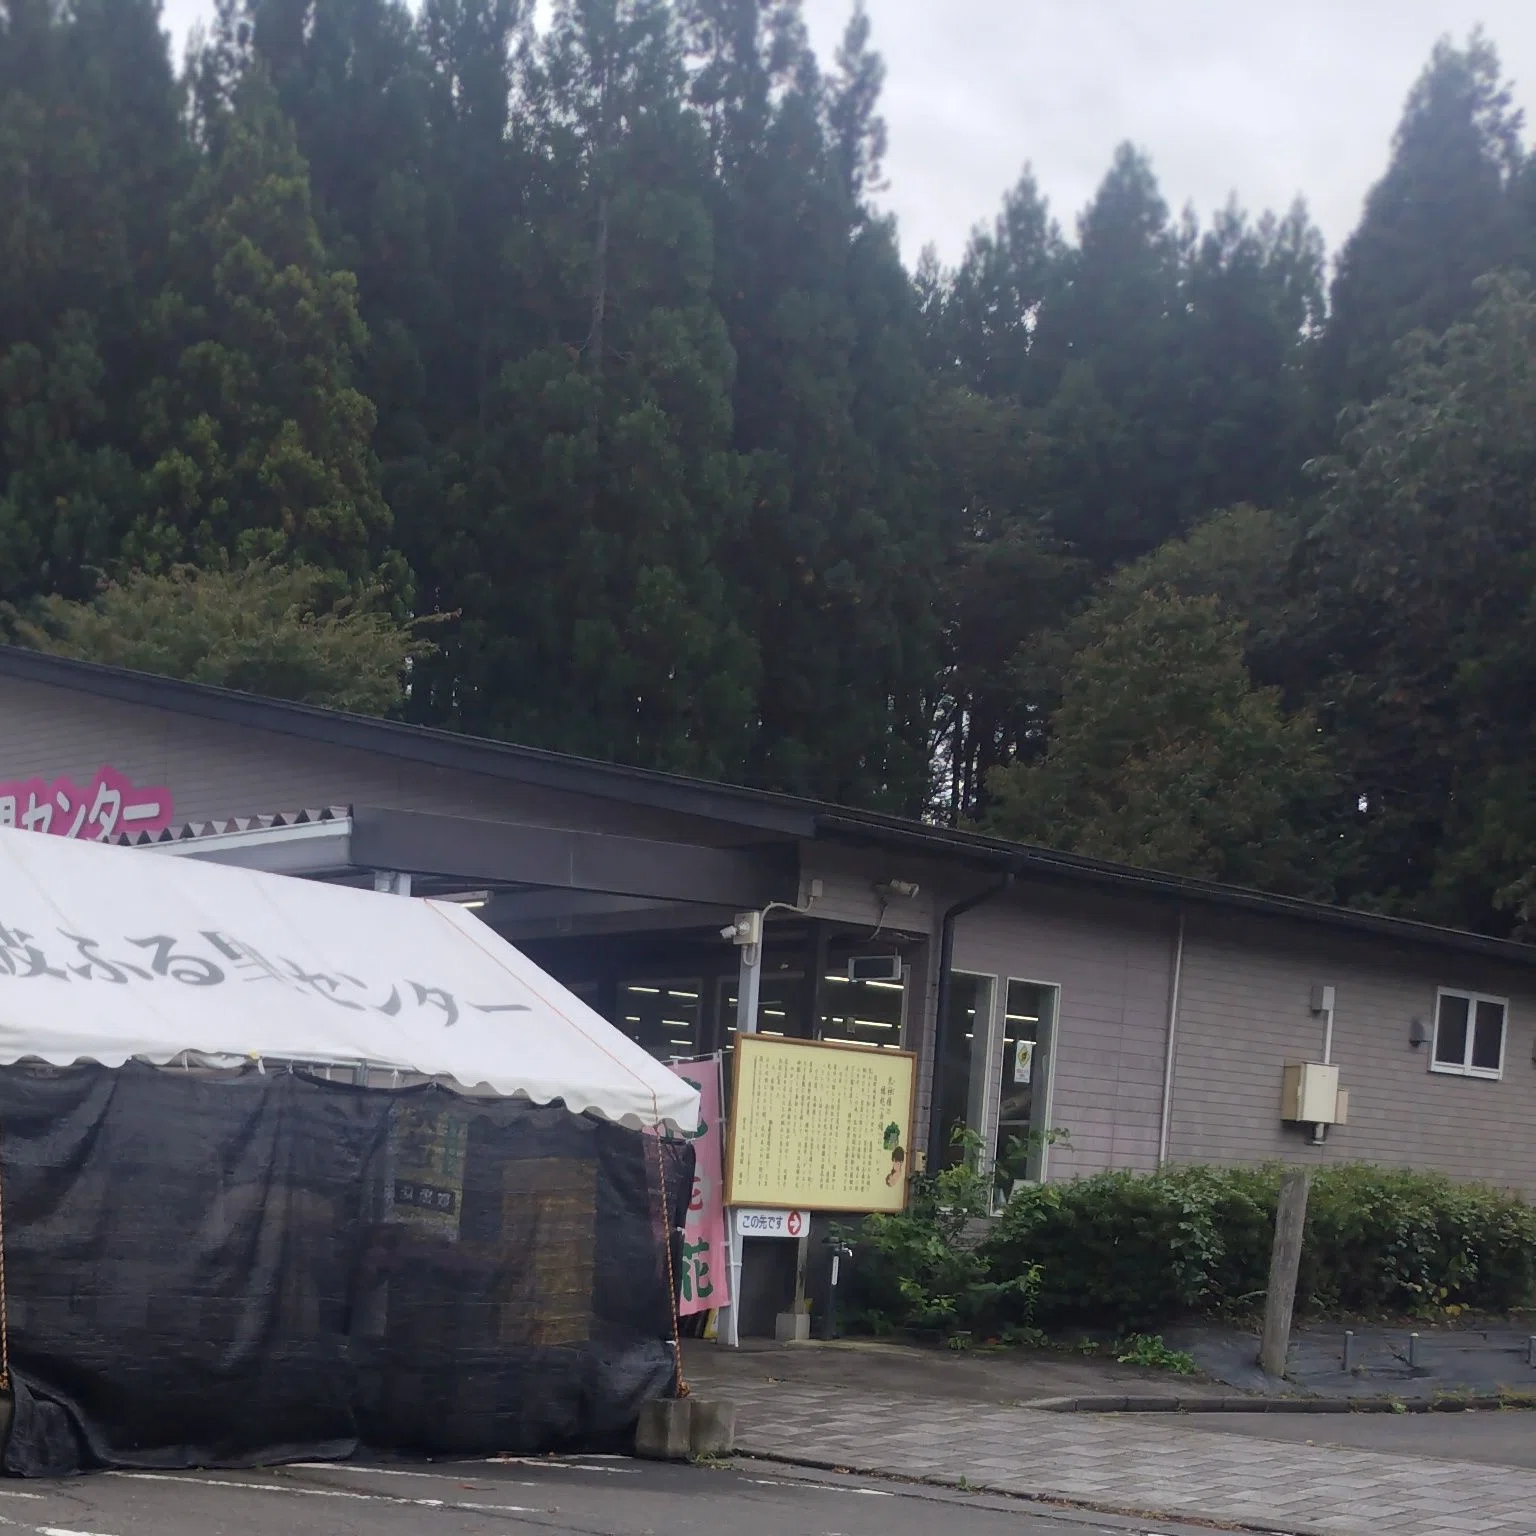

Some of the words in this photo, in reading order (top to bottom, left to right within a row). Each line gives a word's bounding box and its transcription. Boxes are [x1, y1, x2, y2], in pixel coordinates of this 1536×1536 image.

[742, 1214, 784, 1230] この先です
